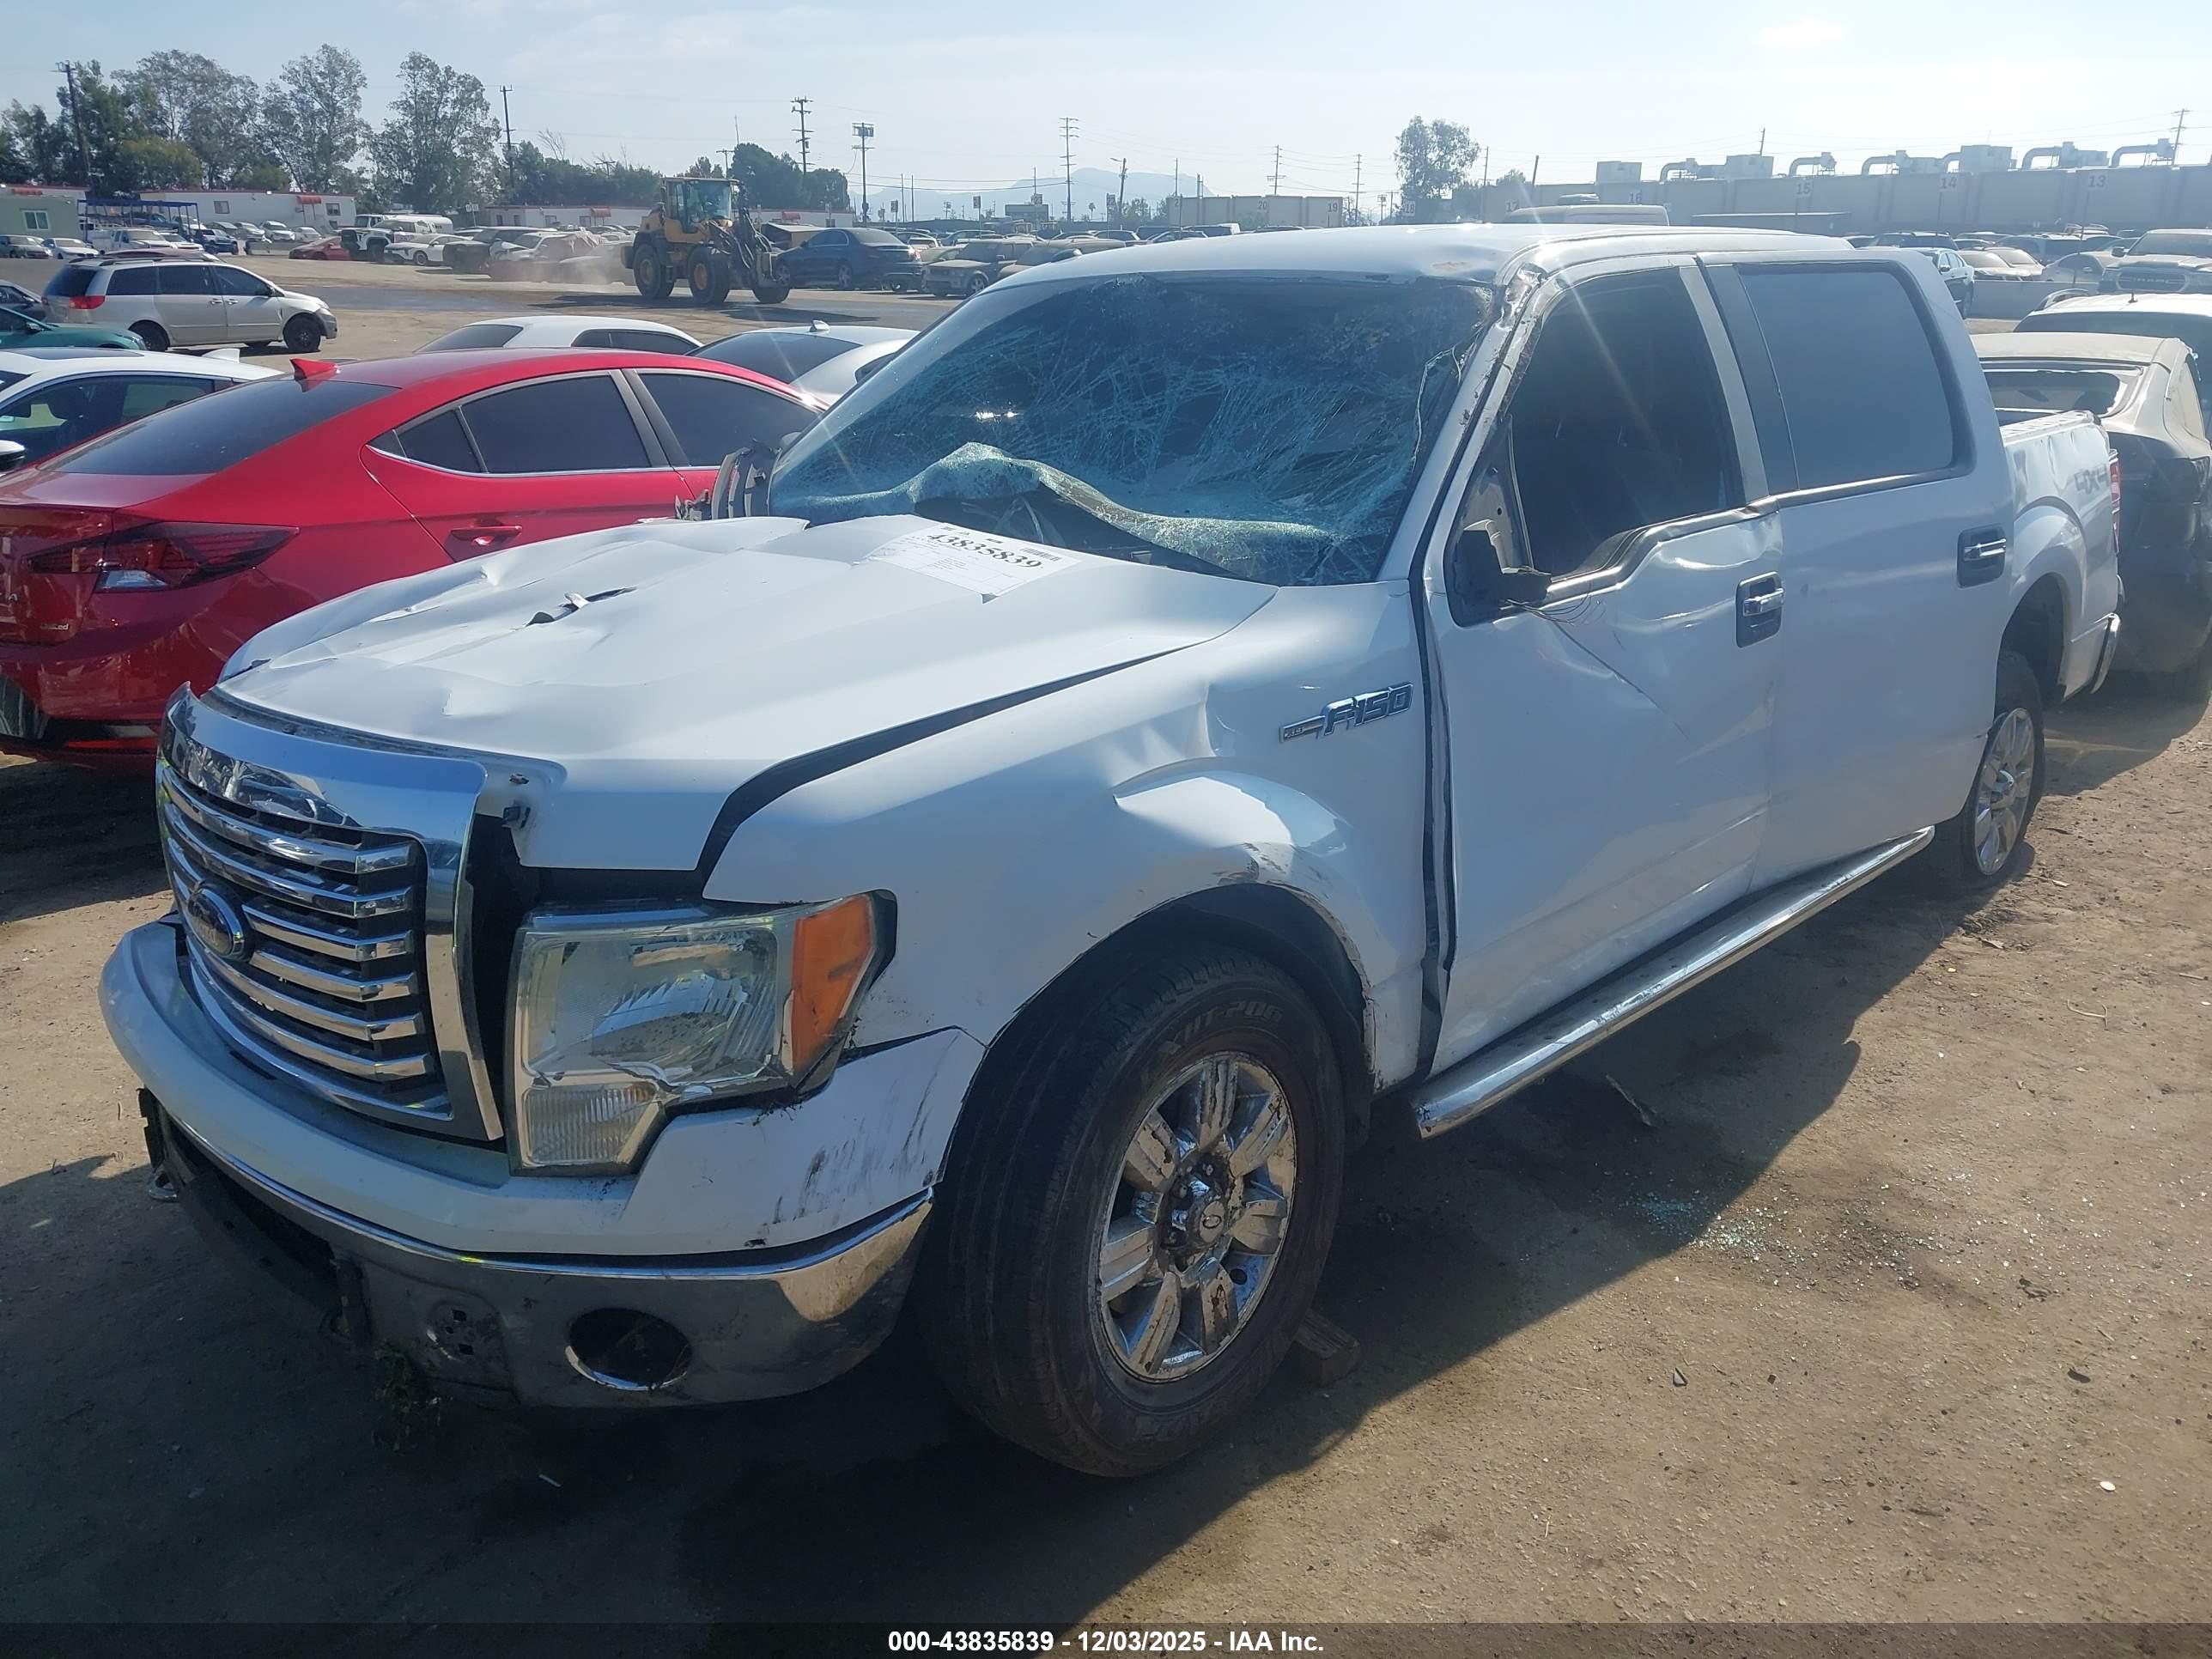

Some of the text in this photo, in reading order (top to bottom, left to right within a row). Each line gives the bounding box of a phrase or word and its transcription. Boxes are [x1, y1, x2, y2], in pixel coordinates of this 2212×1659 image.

[1939, 176, 1957, 189] 14
[2088, 174, 2106, 188] 13
[1796, 182, 1810, 195] 15
[1257, 201, 1268, 211] 20
[1328, 202, 1338, 212] 19
[1405, 203, 1415, 214] 18
[928, 533, 1042, 569] 43835839
